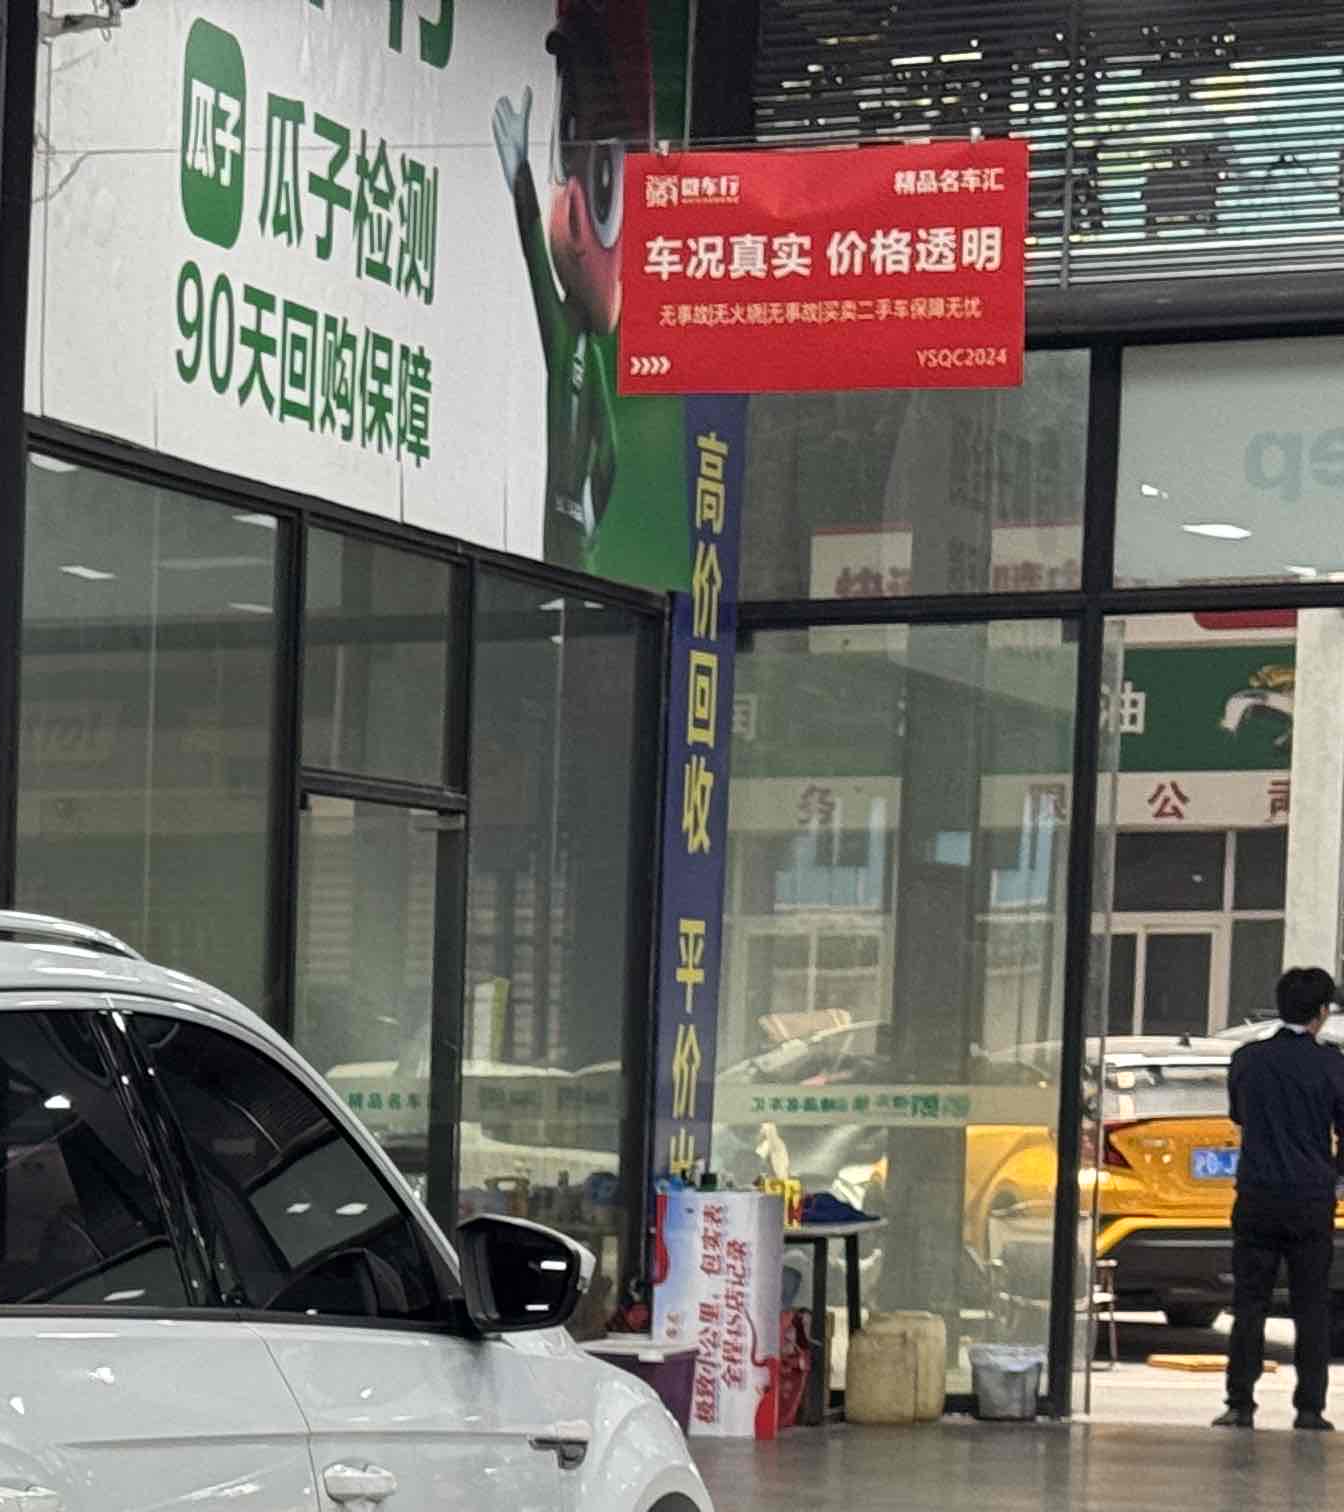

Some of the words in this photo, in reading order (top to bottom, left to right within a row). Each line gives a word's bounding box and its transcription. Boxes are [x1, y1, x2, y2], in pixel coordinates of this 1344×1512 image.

[185, 79, 241, 187] 瓜子
[894, 168, 1004, 195] 精品名车汇
[259, 92, 438, 306] 瓜子检测
[644, 232, 812, 281] 车况真实
[826, 226, 1002, 276] 价格透明
[176, 260, 432, 468] 90天回购保障
[916, 348, 1006, 368] YSQC2024
[682, 432, 728, 854] 高价回收
